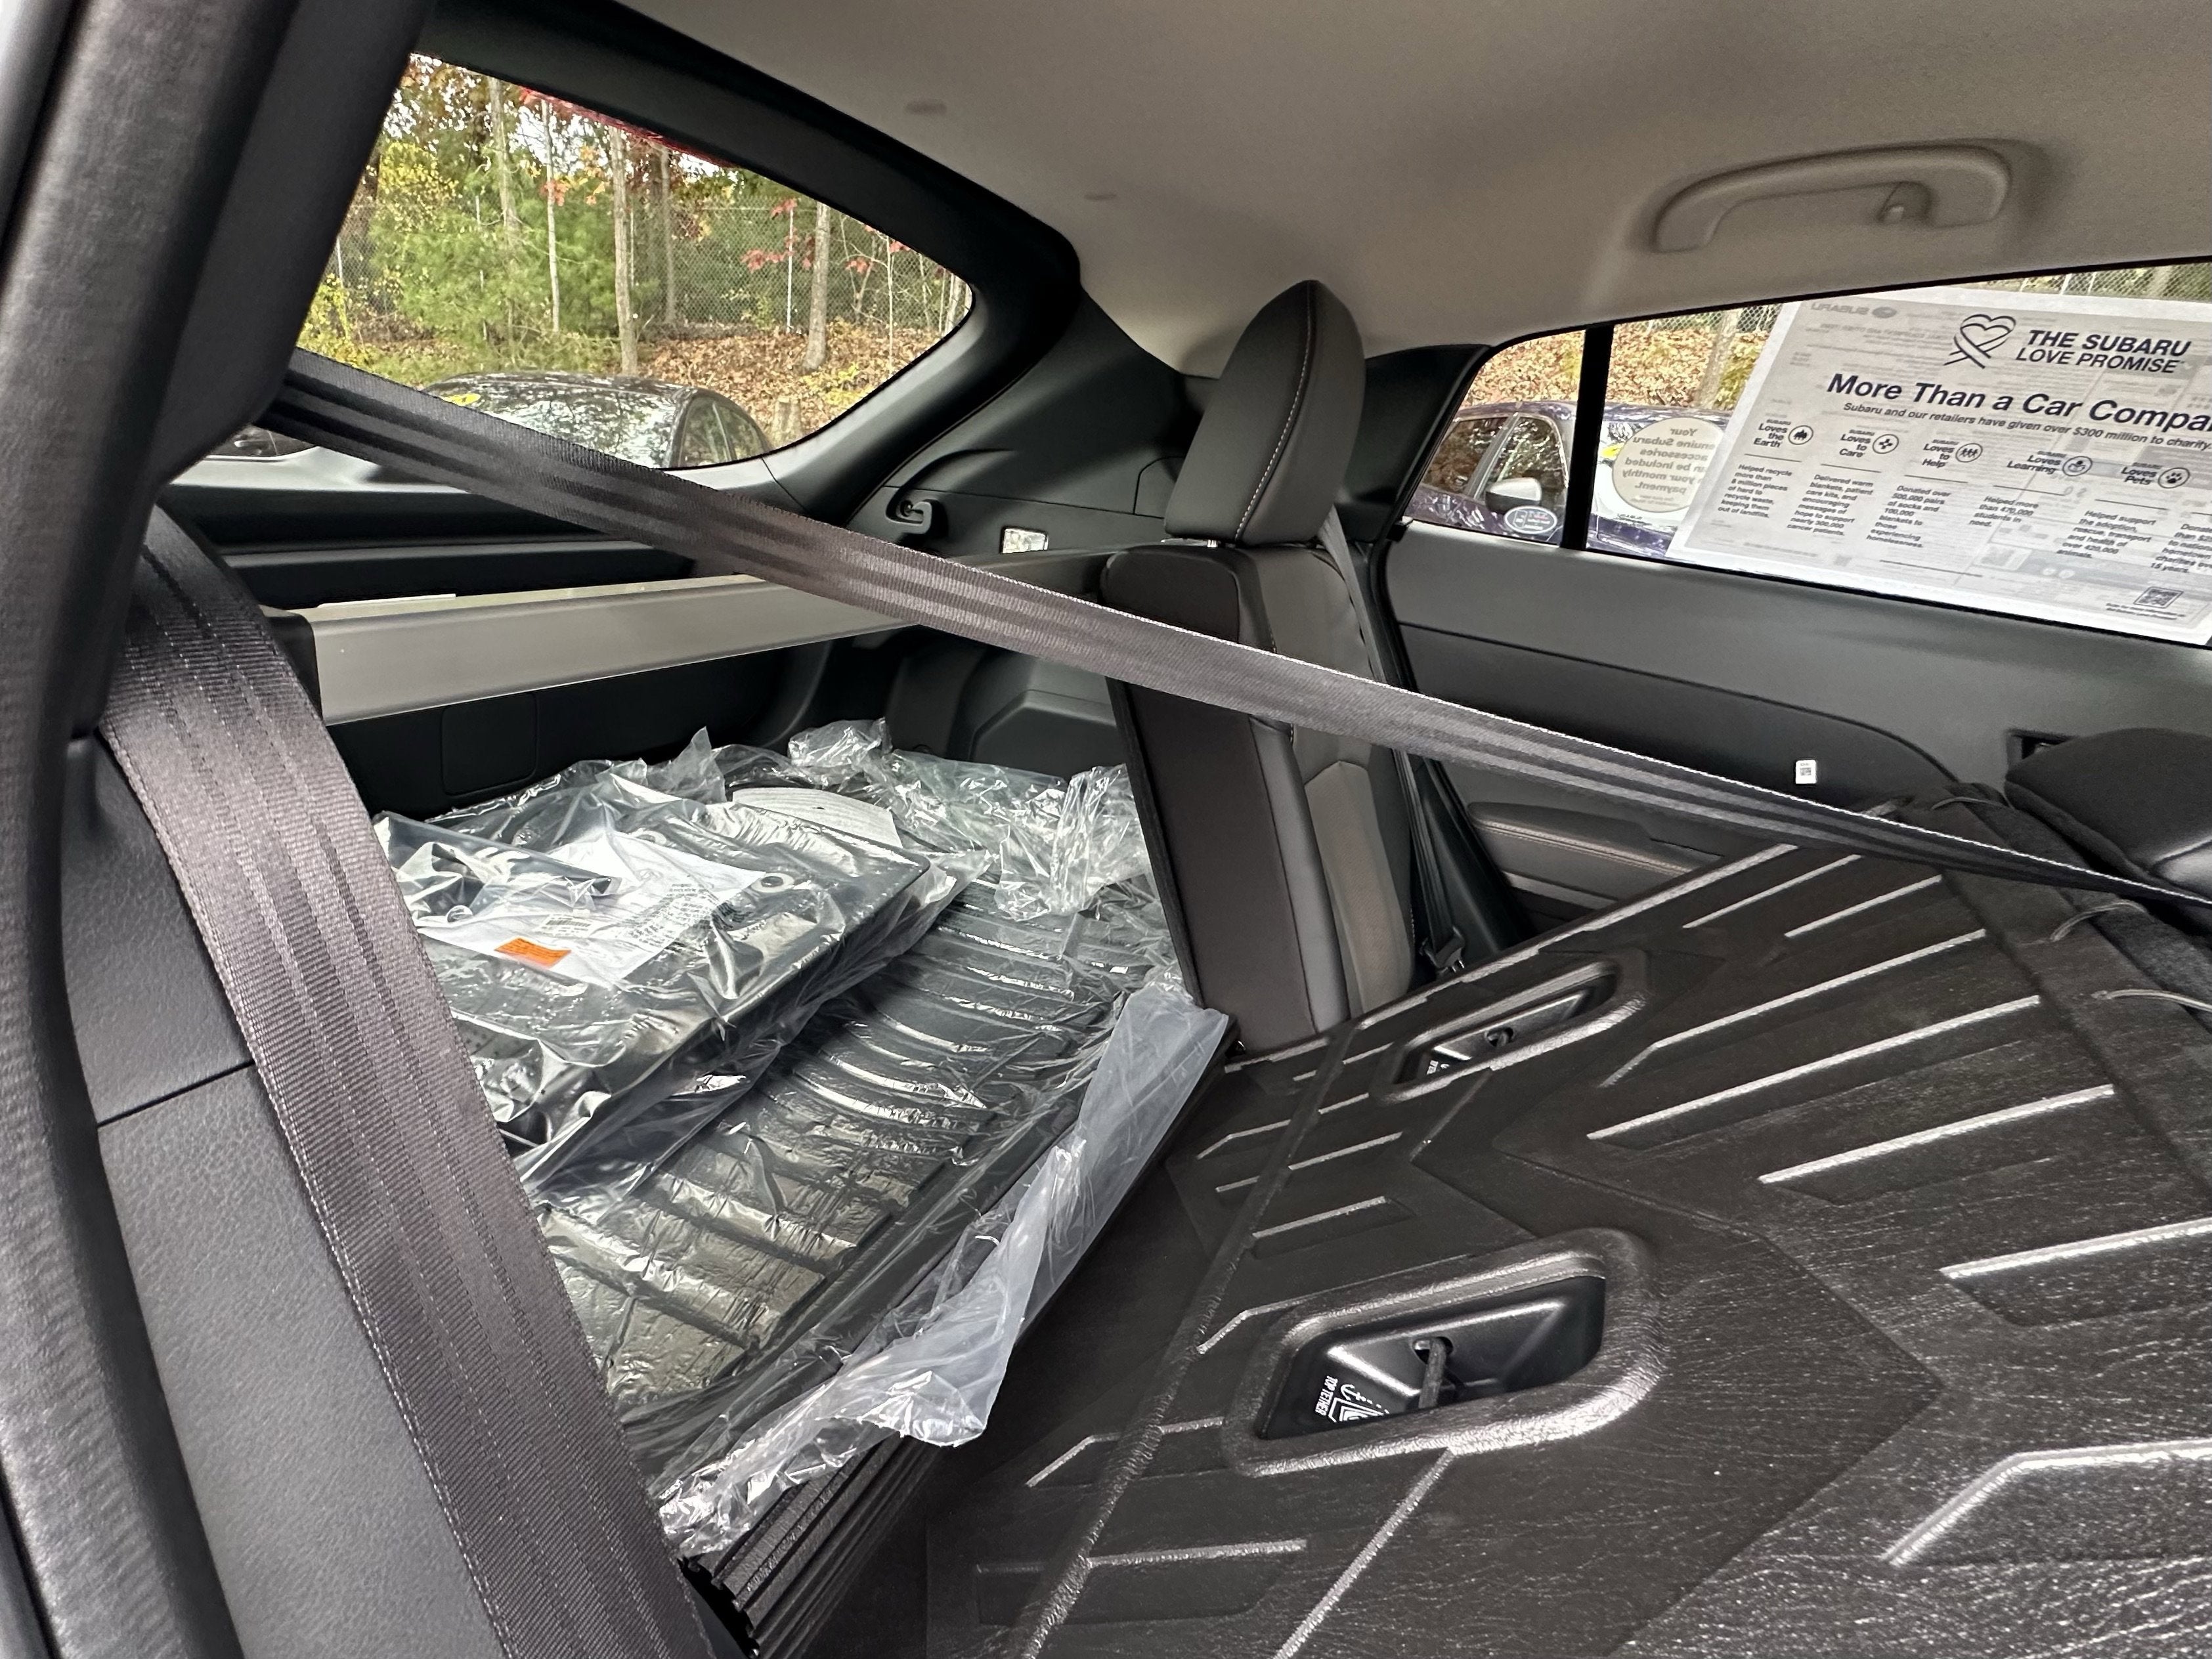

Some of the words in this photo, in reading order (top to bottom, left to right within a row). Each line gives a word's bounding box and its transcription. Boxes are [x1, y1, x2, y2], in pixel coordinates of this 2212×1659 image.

[2028, 330, 2079, 348] THE
[2081, 334, 2192, 356] SUBARU
[2016, 348, 2075, 364] LOVE
[2075, 353, 2180, 373] PROMISE
[1827, 373, 1902, 400] More
[1913, 382, 1985, 409] Than
[1992, 395, 2014, 411] a
[2022, 393, 2083, 417] Car
[2089, 400, 2212, 433] Compa
[1758, 423, 1787, 433] Loves
[1844, 402, 1883, 414] Subaru
[1928, 413, 1976, 424] retailers
[1978, 417, 2006, 427] have
[2006, 421, 2042, 430] given
[2043, 425, 2071, 433] over
[2073, 427, 2104, 439] $300
[2104, 431, 2147, 444] million
[1754, 438, 1781, 448] Earth
[1840, 434, 1871, 444] Loves
[1839, 448, 1864, 458] Care
[1923, 443, 1955, 453] Loves
[1922, 458, 1946, 468] Help
[2027, 455, 2061, 465] Loves
[1738, 464, 1764, 473] Helped
[2006, 460, 2056, 475] Learning
[2121, 466, 2157, 477] Loves
[2124, 475, 2152, 485] Pets
[1896, 485, 1932, 495] Donated
[1984, 496, 2016, 505] Helped
[2084, 510, 2118, 520] Helped
[1324, 1375, 1338, 1391] TOP
[1315, 1389, 1334, 1416] TETHER
